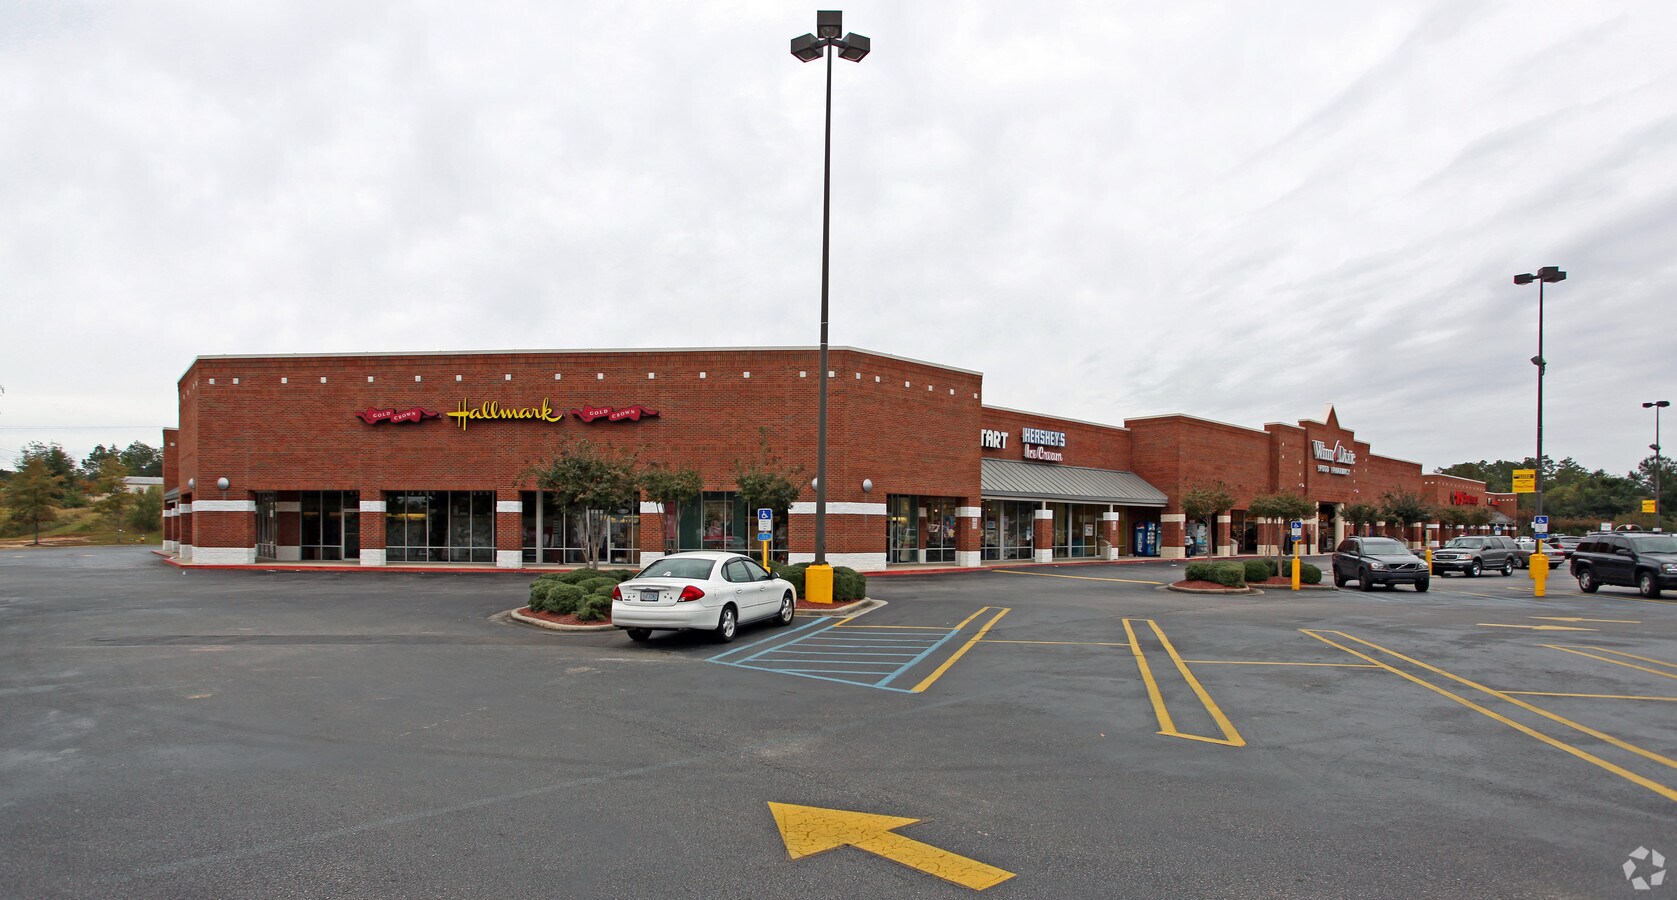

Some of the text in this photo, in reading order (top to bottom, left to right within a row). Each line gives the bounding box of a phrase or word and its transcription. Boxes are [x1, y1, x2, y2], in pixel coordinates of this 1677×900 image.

[393, 411, 416, 420] CROWN
[446, 397, 562, 431] Hallmark
[611, 409, 635, 418] CROWN
